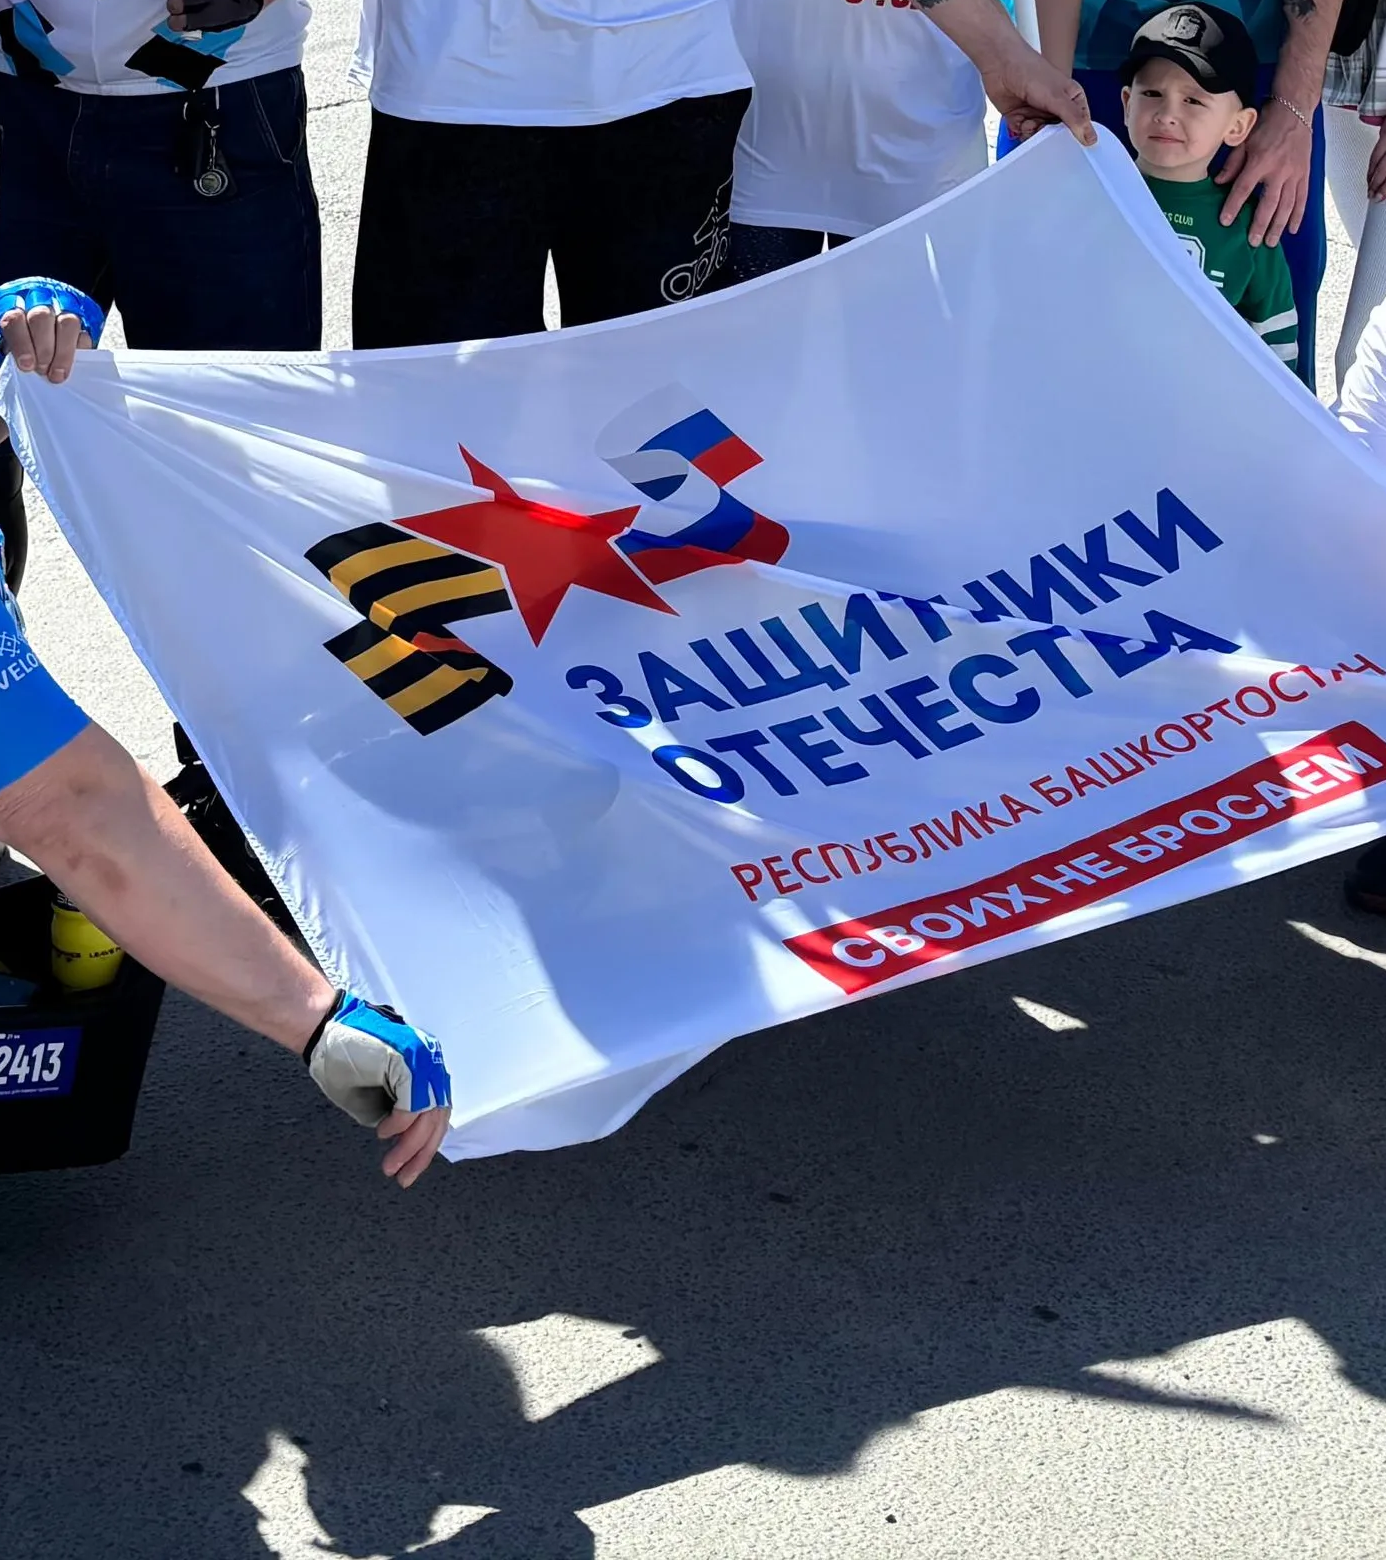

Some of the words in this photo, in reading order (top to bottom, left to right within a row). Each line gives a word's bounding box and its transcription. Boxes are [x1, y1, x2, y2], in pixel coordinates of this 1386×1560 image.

[564, 486, 1225, 730] ЗАЩИТНИКИ
[650, 605, 1241, 805] ОТЕЧЕСТВА
[730, 792, 1044, 903] РЕСПУБЛИКА
[829, 873, 1047, 970] СВОИХ
[1047, 844, 1117, 898] НЕ
[1116, 742, 1384, 868] БРОСАЕМ
